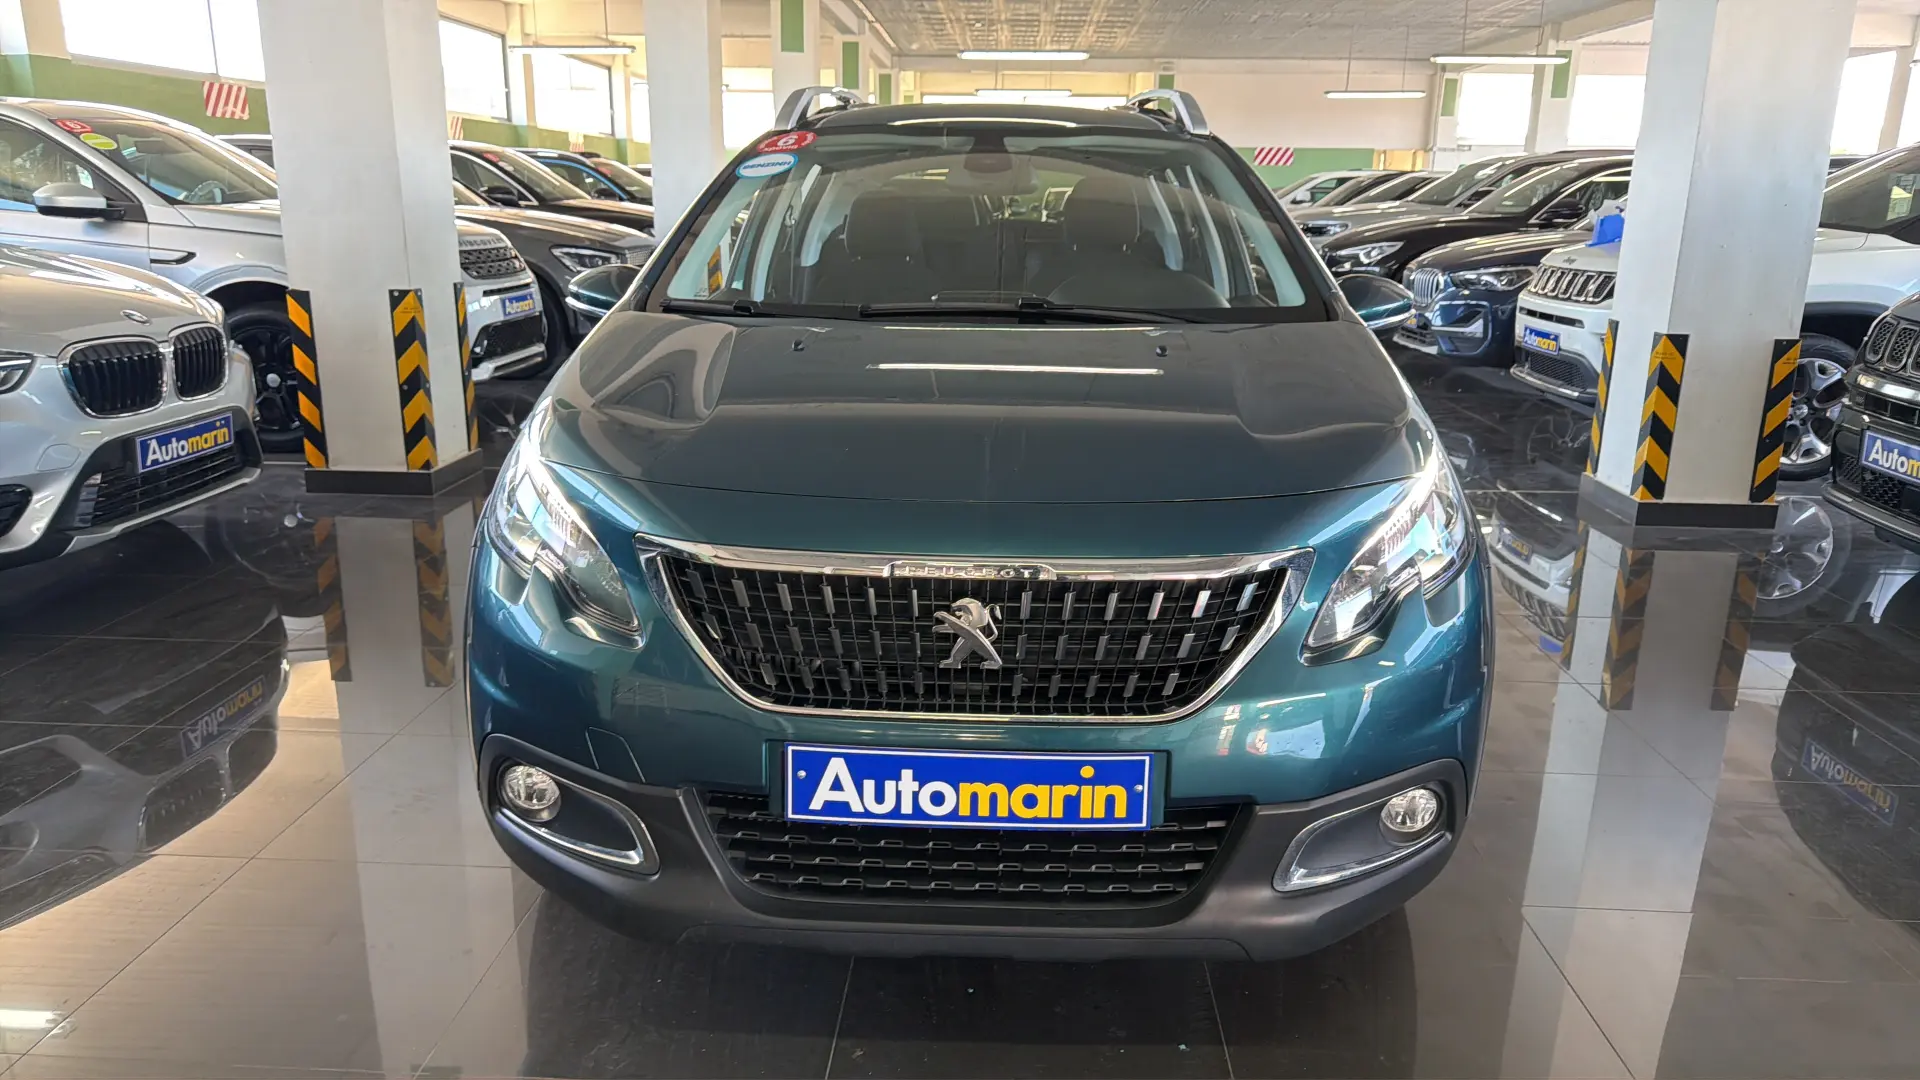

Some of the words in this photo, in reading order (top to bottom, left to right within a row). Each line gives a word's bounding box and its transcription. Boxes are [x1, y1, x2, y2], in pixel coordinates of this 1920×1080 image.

[776, 135, 799, 147] 6
[146, 421, 229, 467] Automarin
[902, 565, 1033, 579] PEUGEOT
[808, 757, 1128, 819] Automarin
